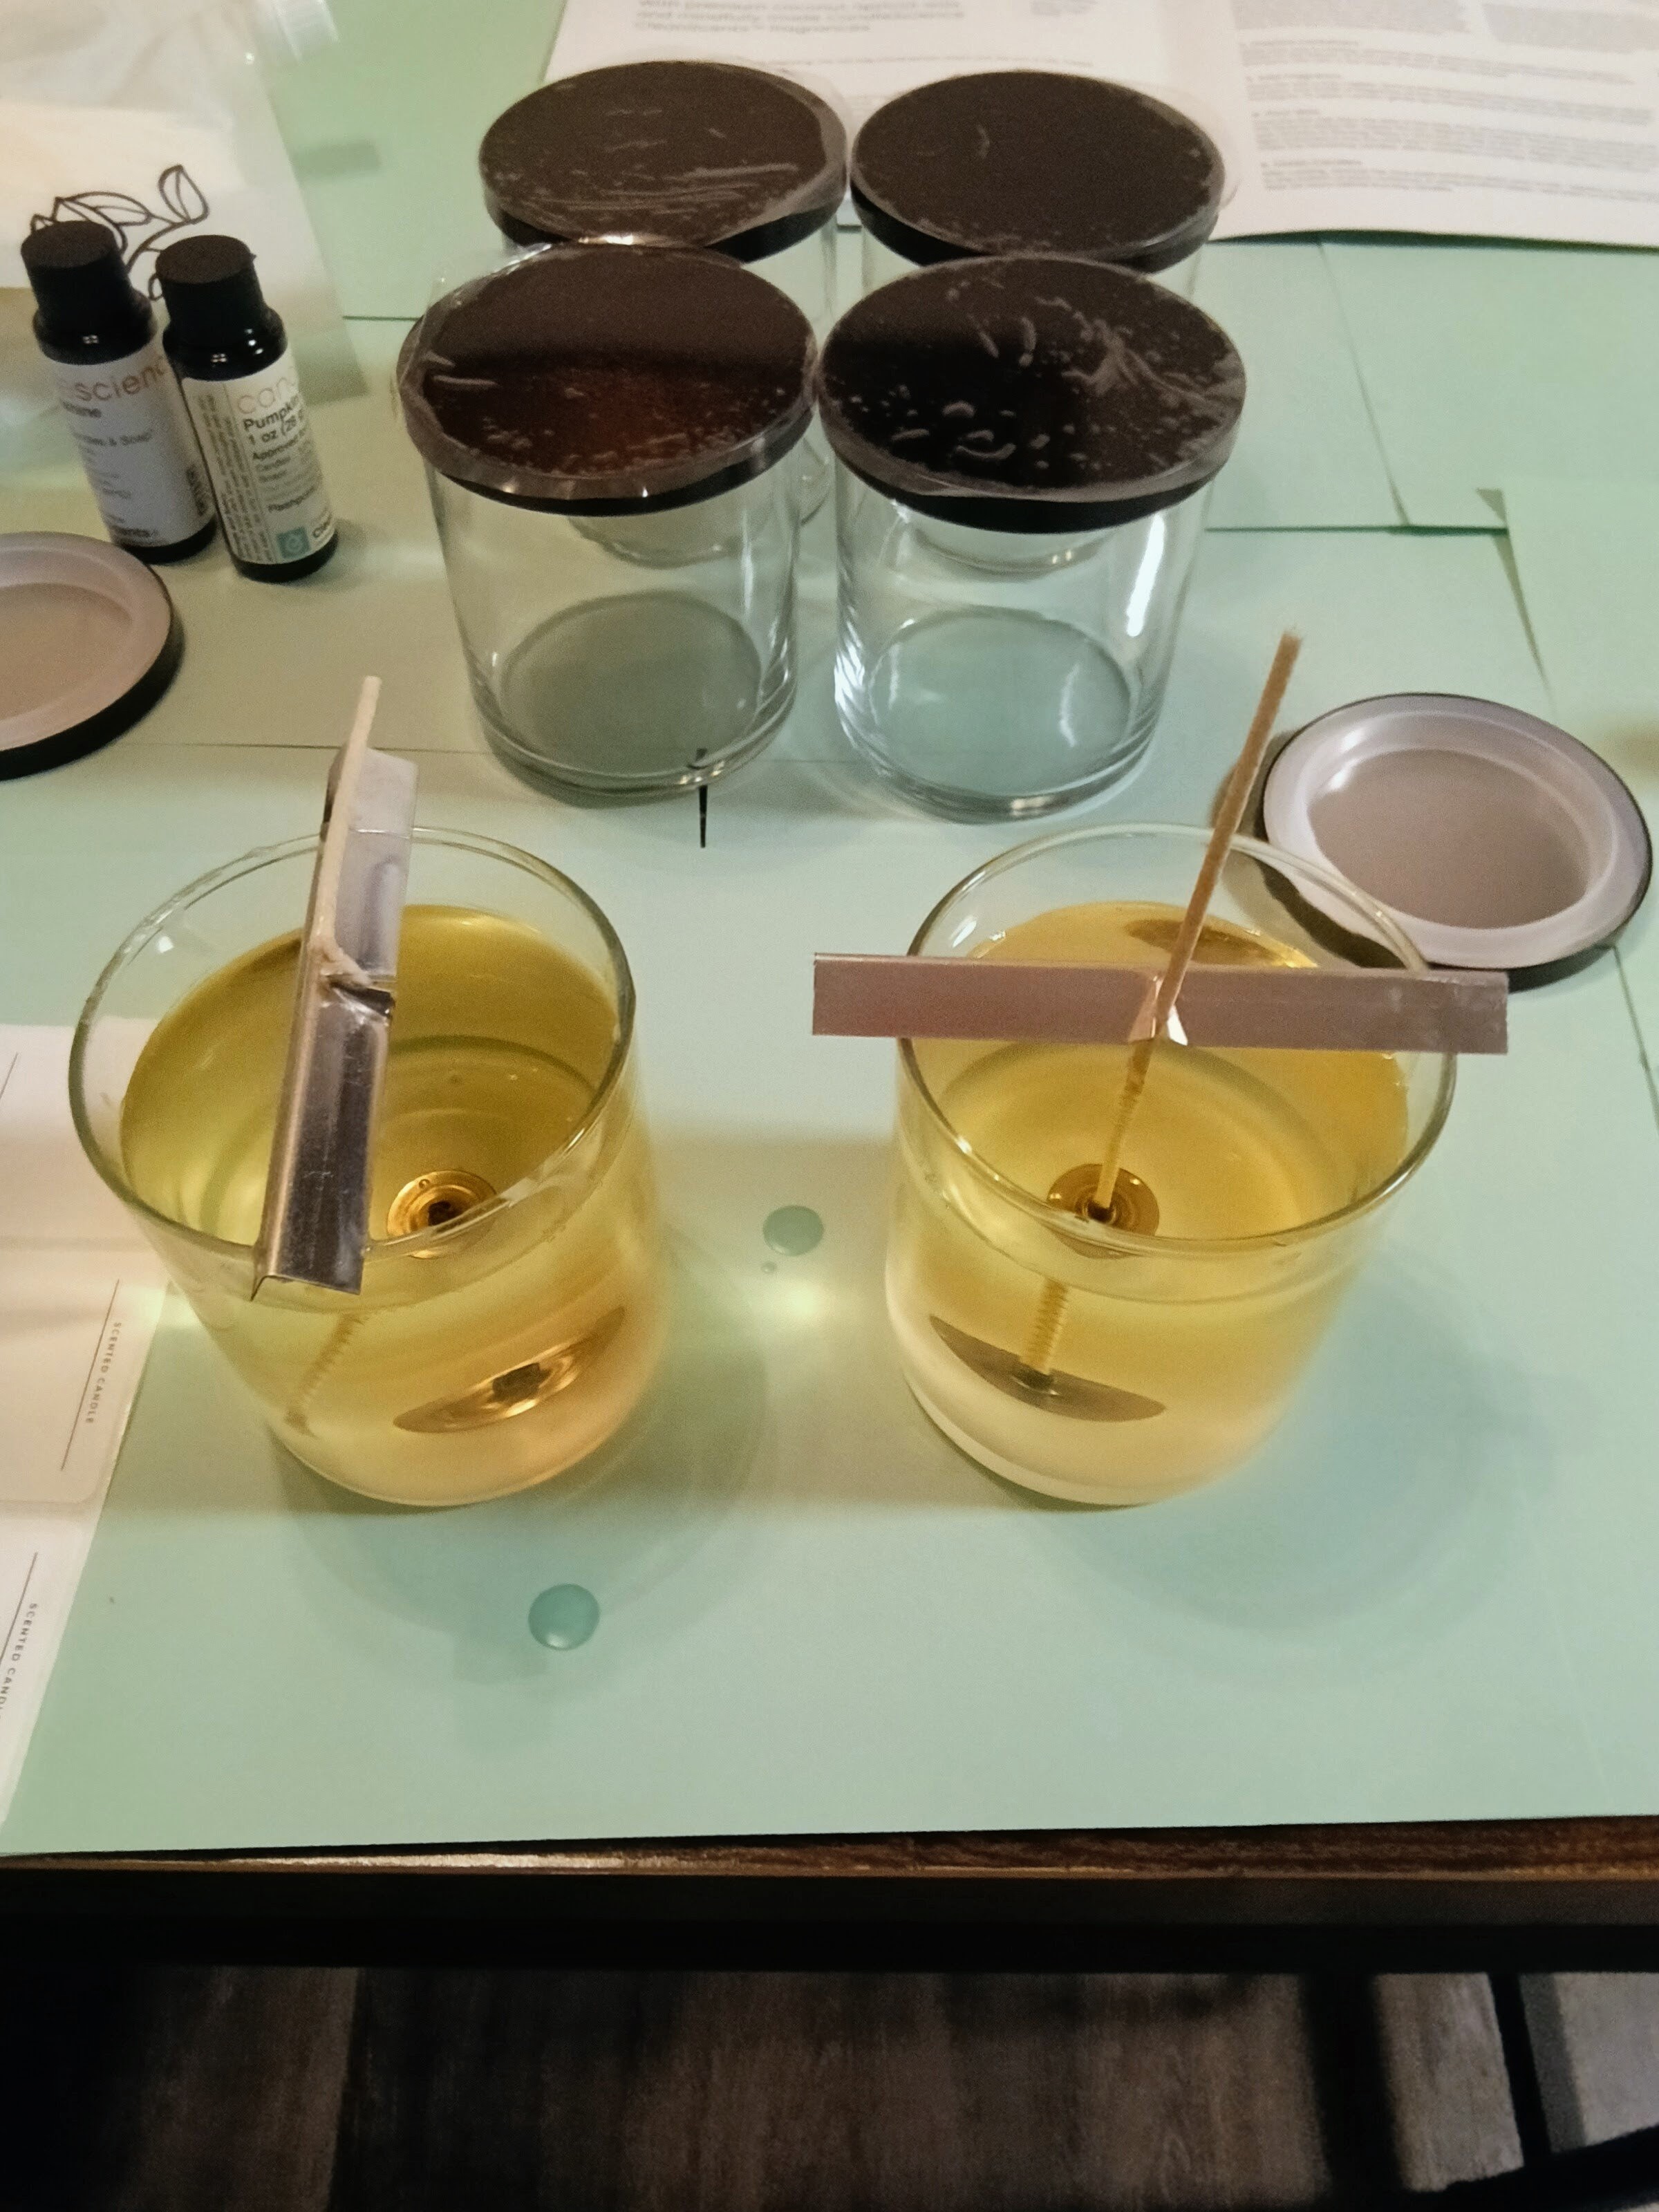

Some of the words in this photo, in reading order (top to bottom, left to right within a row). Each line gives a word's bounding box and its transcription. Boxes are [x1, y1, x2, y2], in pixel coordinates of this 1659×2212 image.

[261, 430, 278, 443] oz
[100, 1322, 122, 1373] SCENTED
[85, 1377, 105, 1424] CANDLE
[12, 1602, 38, 1662] SCENTED
[0, 1667, 16, 1711] CAND
